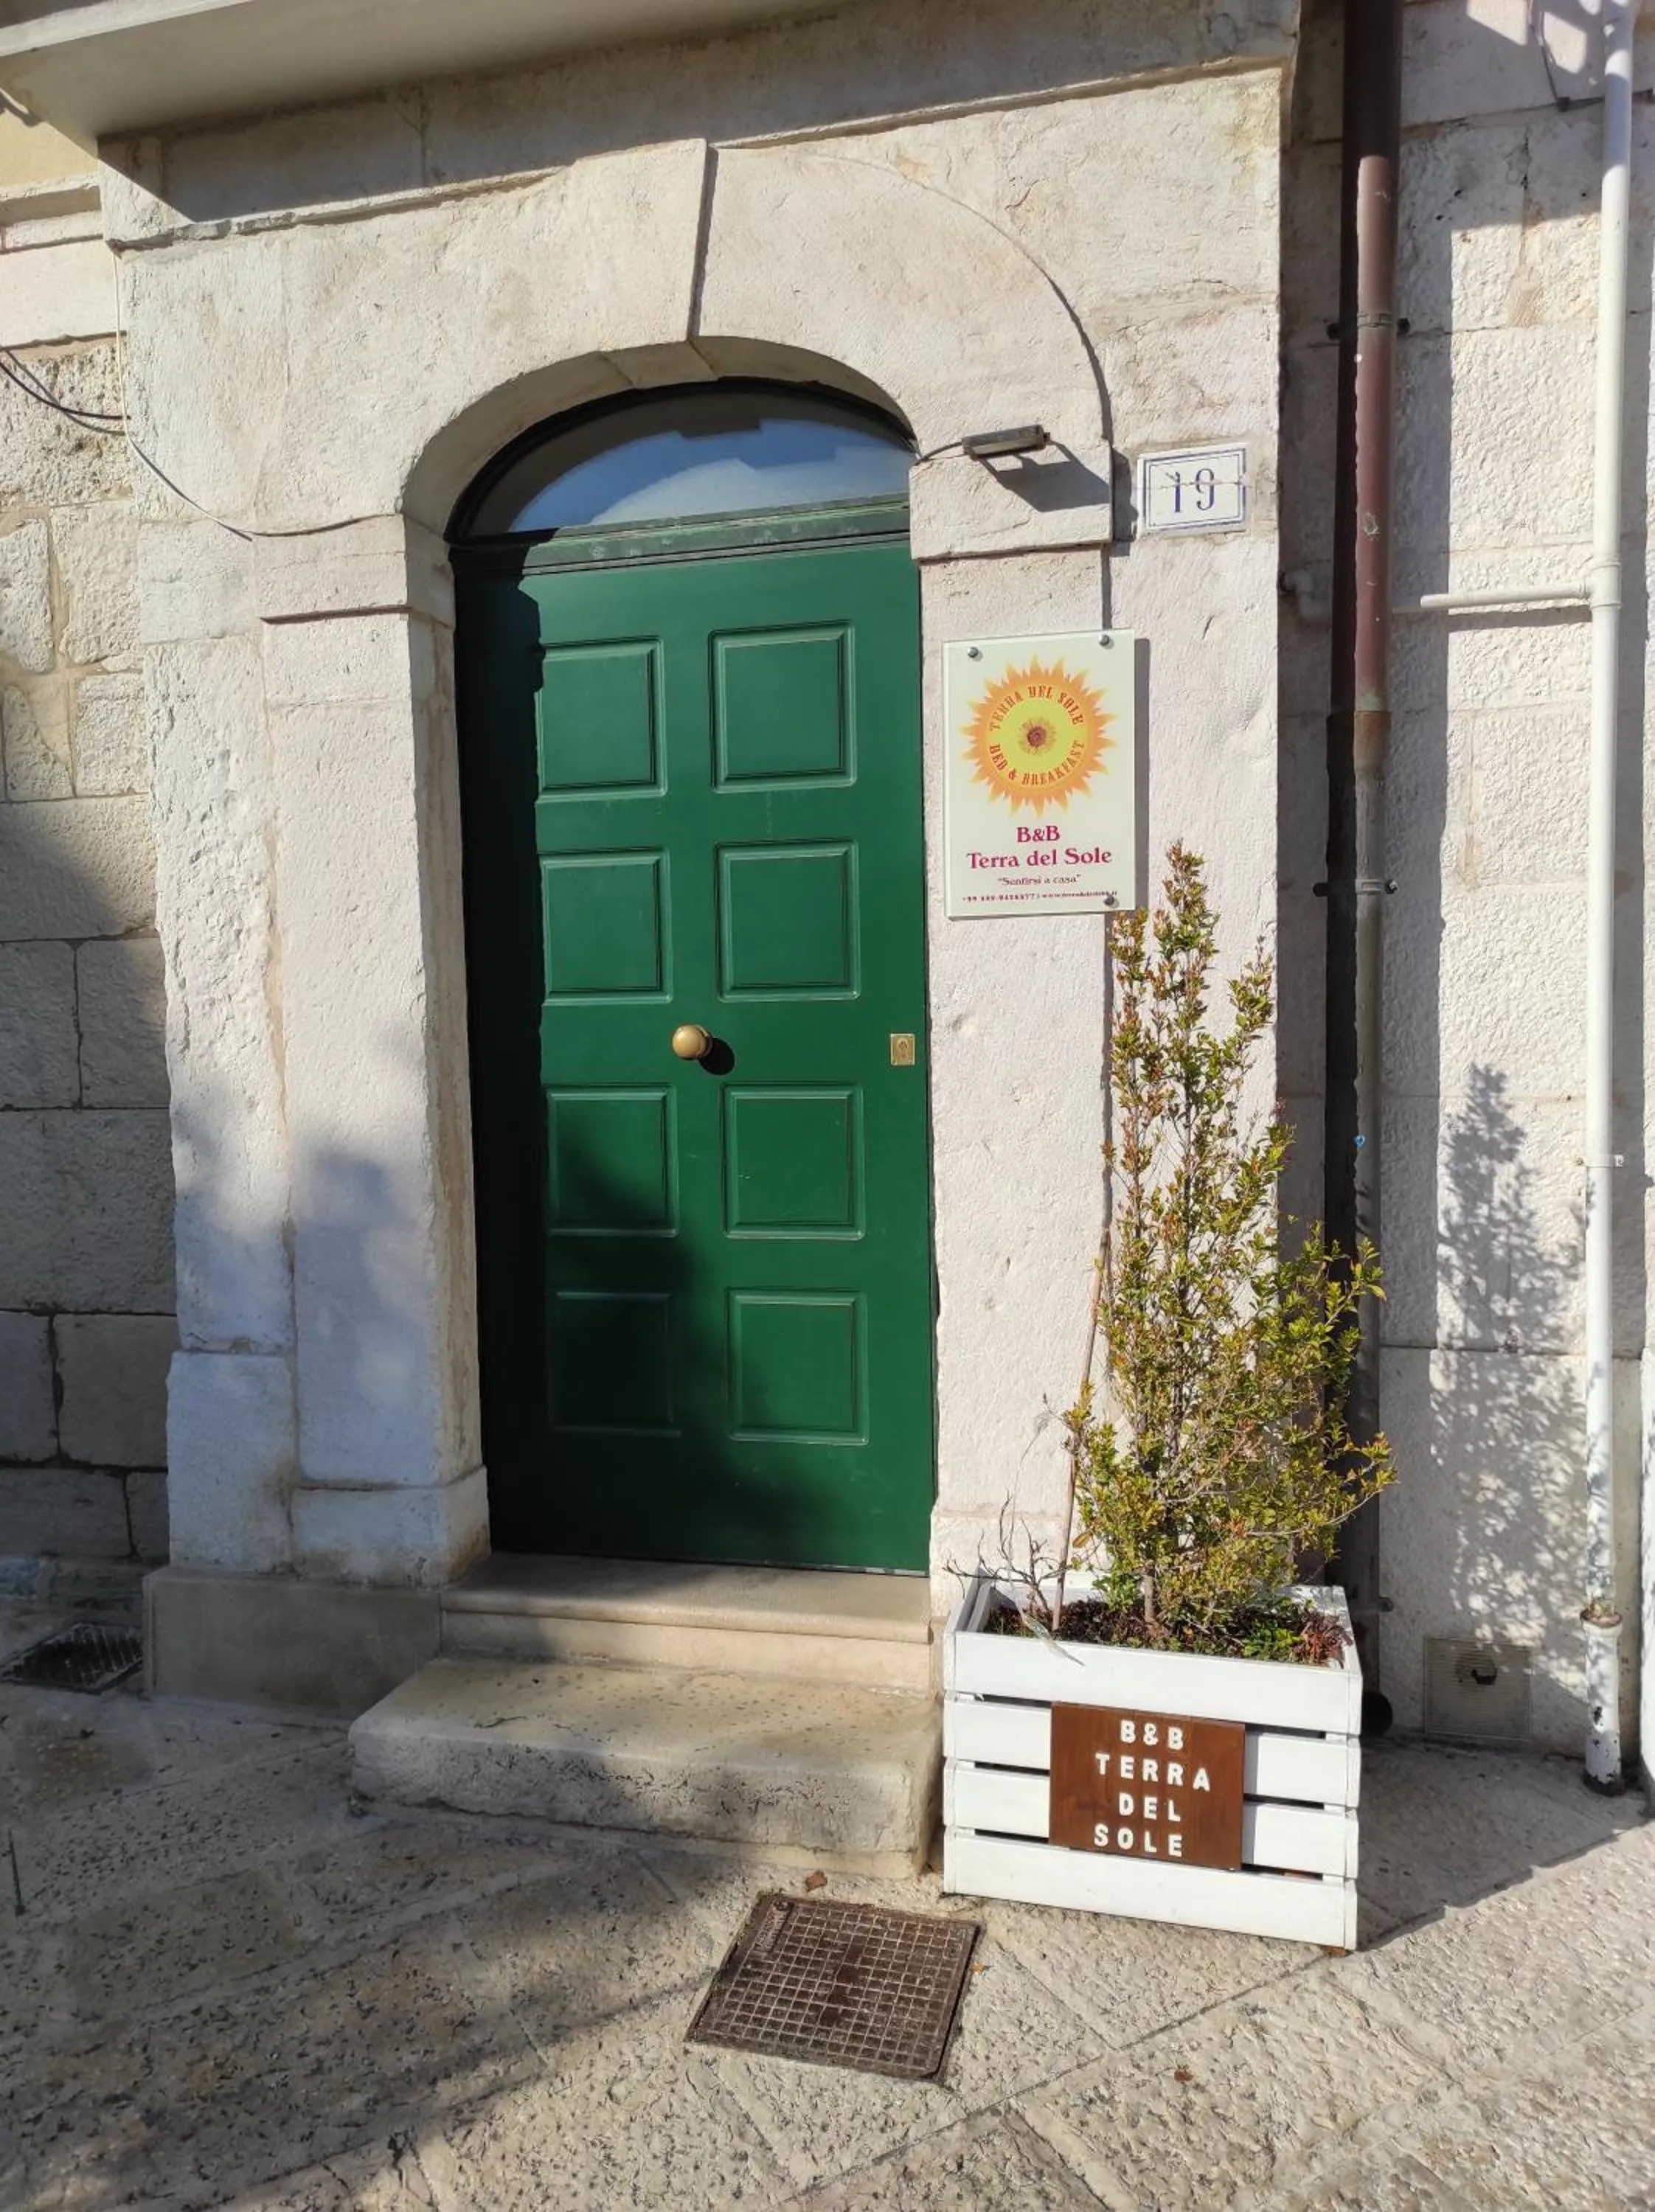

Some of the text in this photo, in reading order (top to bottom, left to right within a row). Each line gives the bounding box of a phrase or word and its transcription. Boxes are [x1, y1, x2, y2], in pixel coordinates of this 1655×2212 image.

[1165, 467, 1215, 513] 19
[990, 684, 1084, 732] TERRA DEL SOLE
[989, 742, 1008, 771] BED
[1021, 740, 1085, 786] BREAKFAST
[1016, 825, 1061, 844] B&B
[966, 846, 1112, 869] Terra del Sole
[1094, 1752, 1210, 1792] TERRA
[1119, 1792, 1181, 1822] DEL
[1094, 1823, 1183, 1857] SOLE
